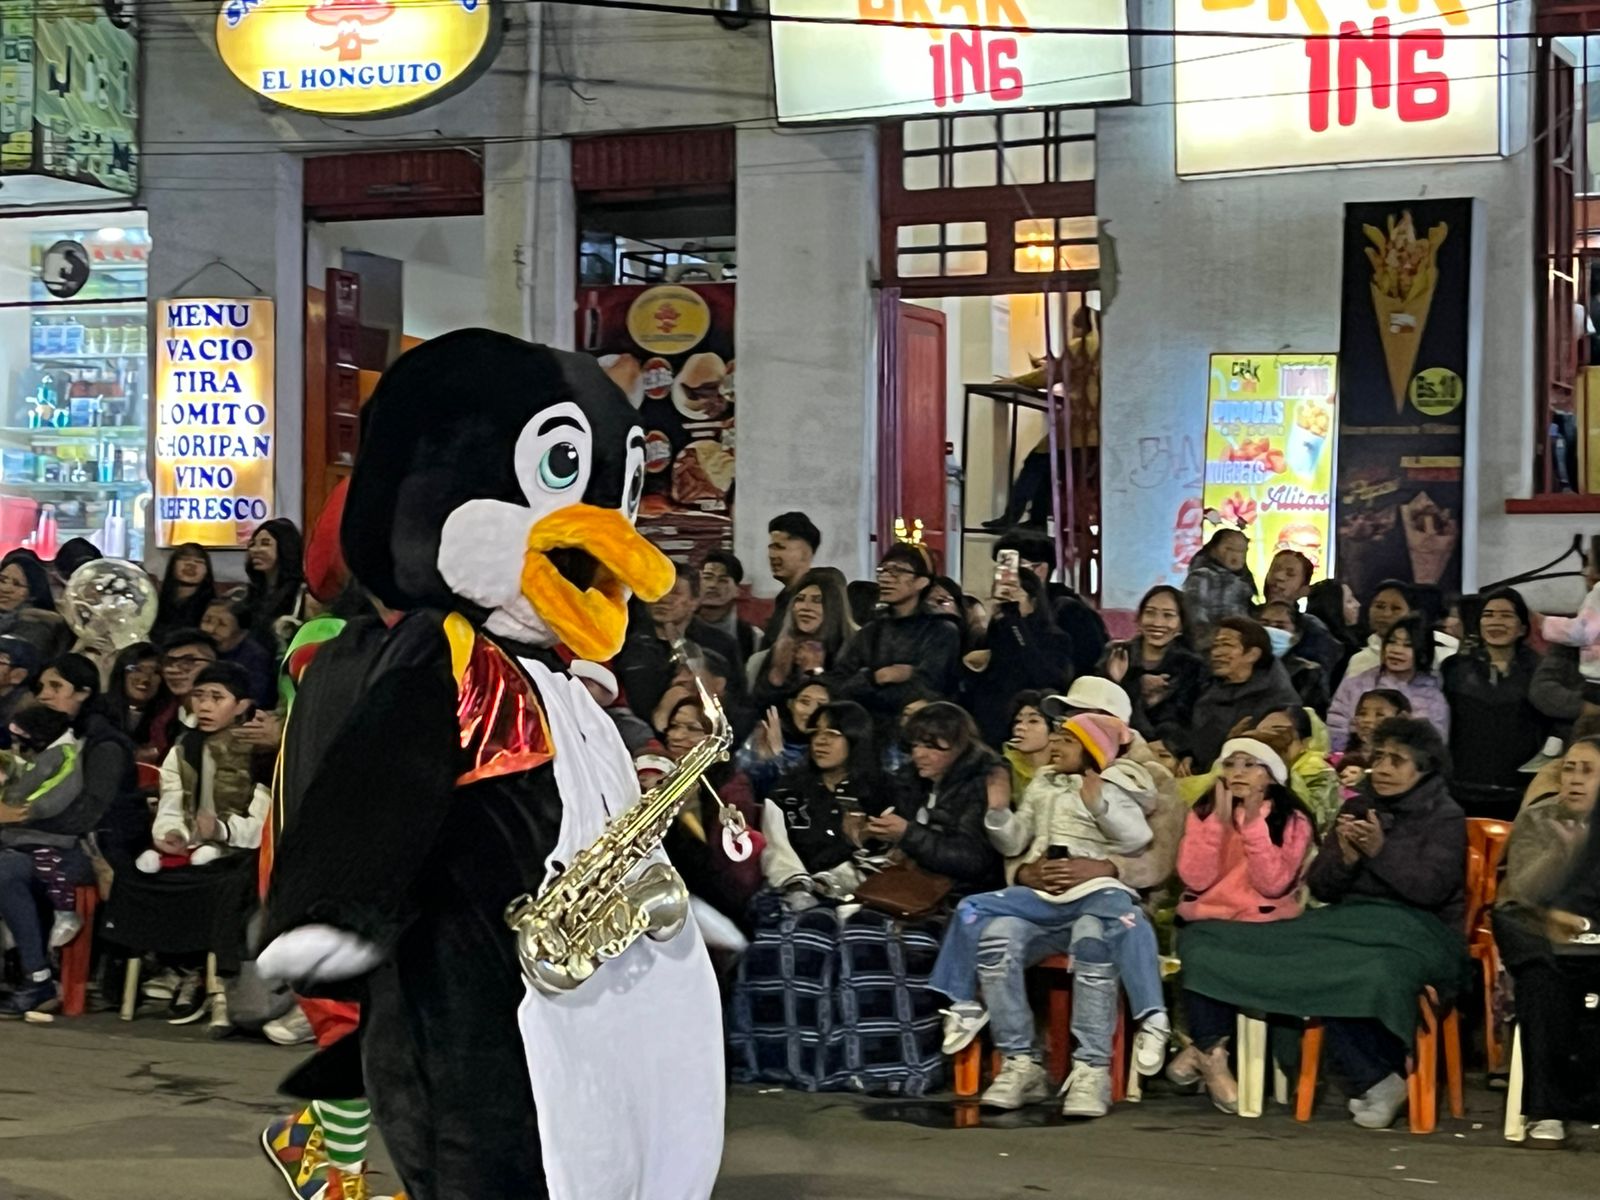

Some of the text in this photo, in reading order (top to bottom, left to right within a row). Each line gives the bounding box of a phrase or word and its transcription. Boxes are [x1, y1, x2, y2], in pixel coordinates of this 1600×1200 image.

[262, 62, 442, 90] EL HONGUITO
[167, 304, 249, 328] MENU
[166, 339, 254, 361] VACIO
[173, 370, 242, 393] TIRA
[160, 402, 266, 425] LOMITO
[175, 465, 233, 489] VINO
[1261, 484, 1331, 512] Alitas
